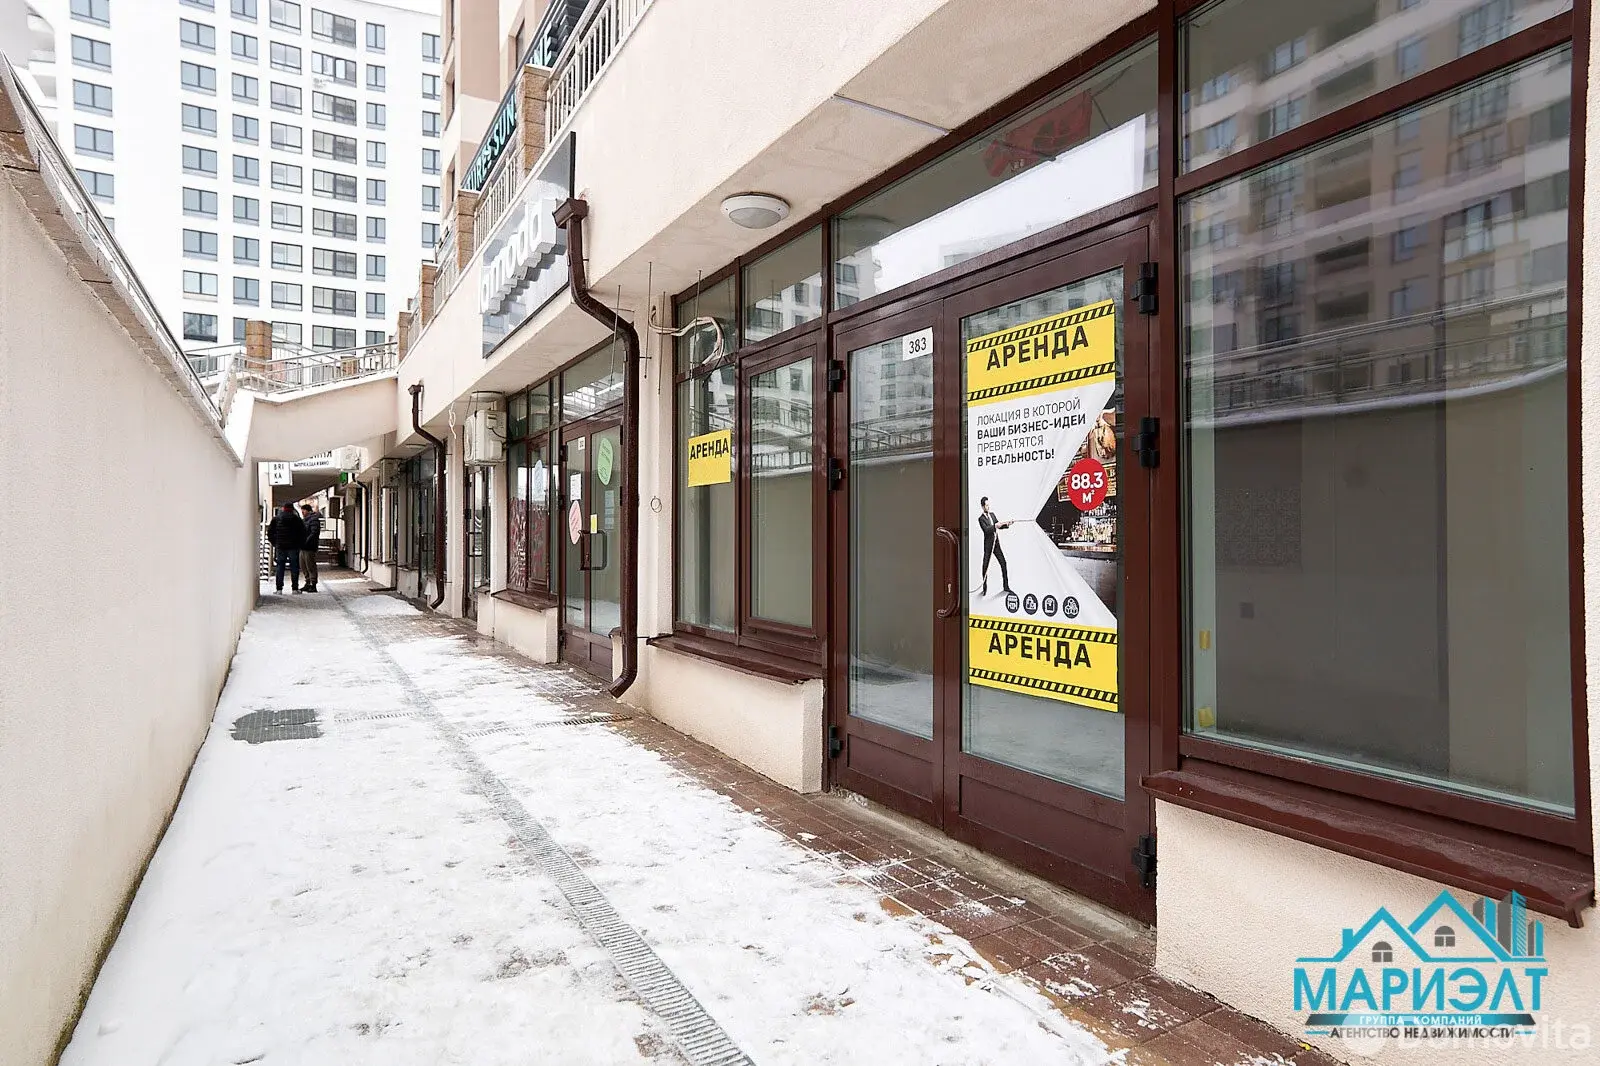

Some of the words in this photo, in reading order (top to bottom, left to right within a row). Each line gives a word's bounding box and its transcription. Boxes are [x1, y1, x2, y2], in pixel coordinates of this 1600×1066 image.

[909, 337, 927, 355] 383
[986, 325, 1089, 371] АРЕНДА
[977, 408, 1021, 426] ЛОКАЦИЯ
[1023, 407, 1030, 419] В
[1032, 397, 1081, 417] КОТОРОЙ
[977, 425, 1006, 440] ВАШИ
[1008, 413, 1086, 436] БИЗНЕС-ИДЕИ
[690, 437, 730, 460] АРЕНДА
[977, 435, 1044, 453] ПРЕВРАТЯТСЯ
[977, 456, 984, 467] В
[985, 448, 1055, 466] РЕАЛЬНОСТЬ!
[1071, 471, 1104, 490] 88.3
[988, 632, 1092, 669] АРЕНДА
